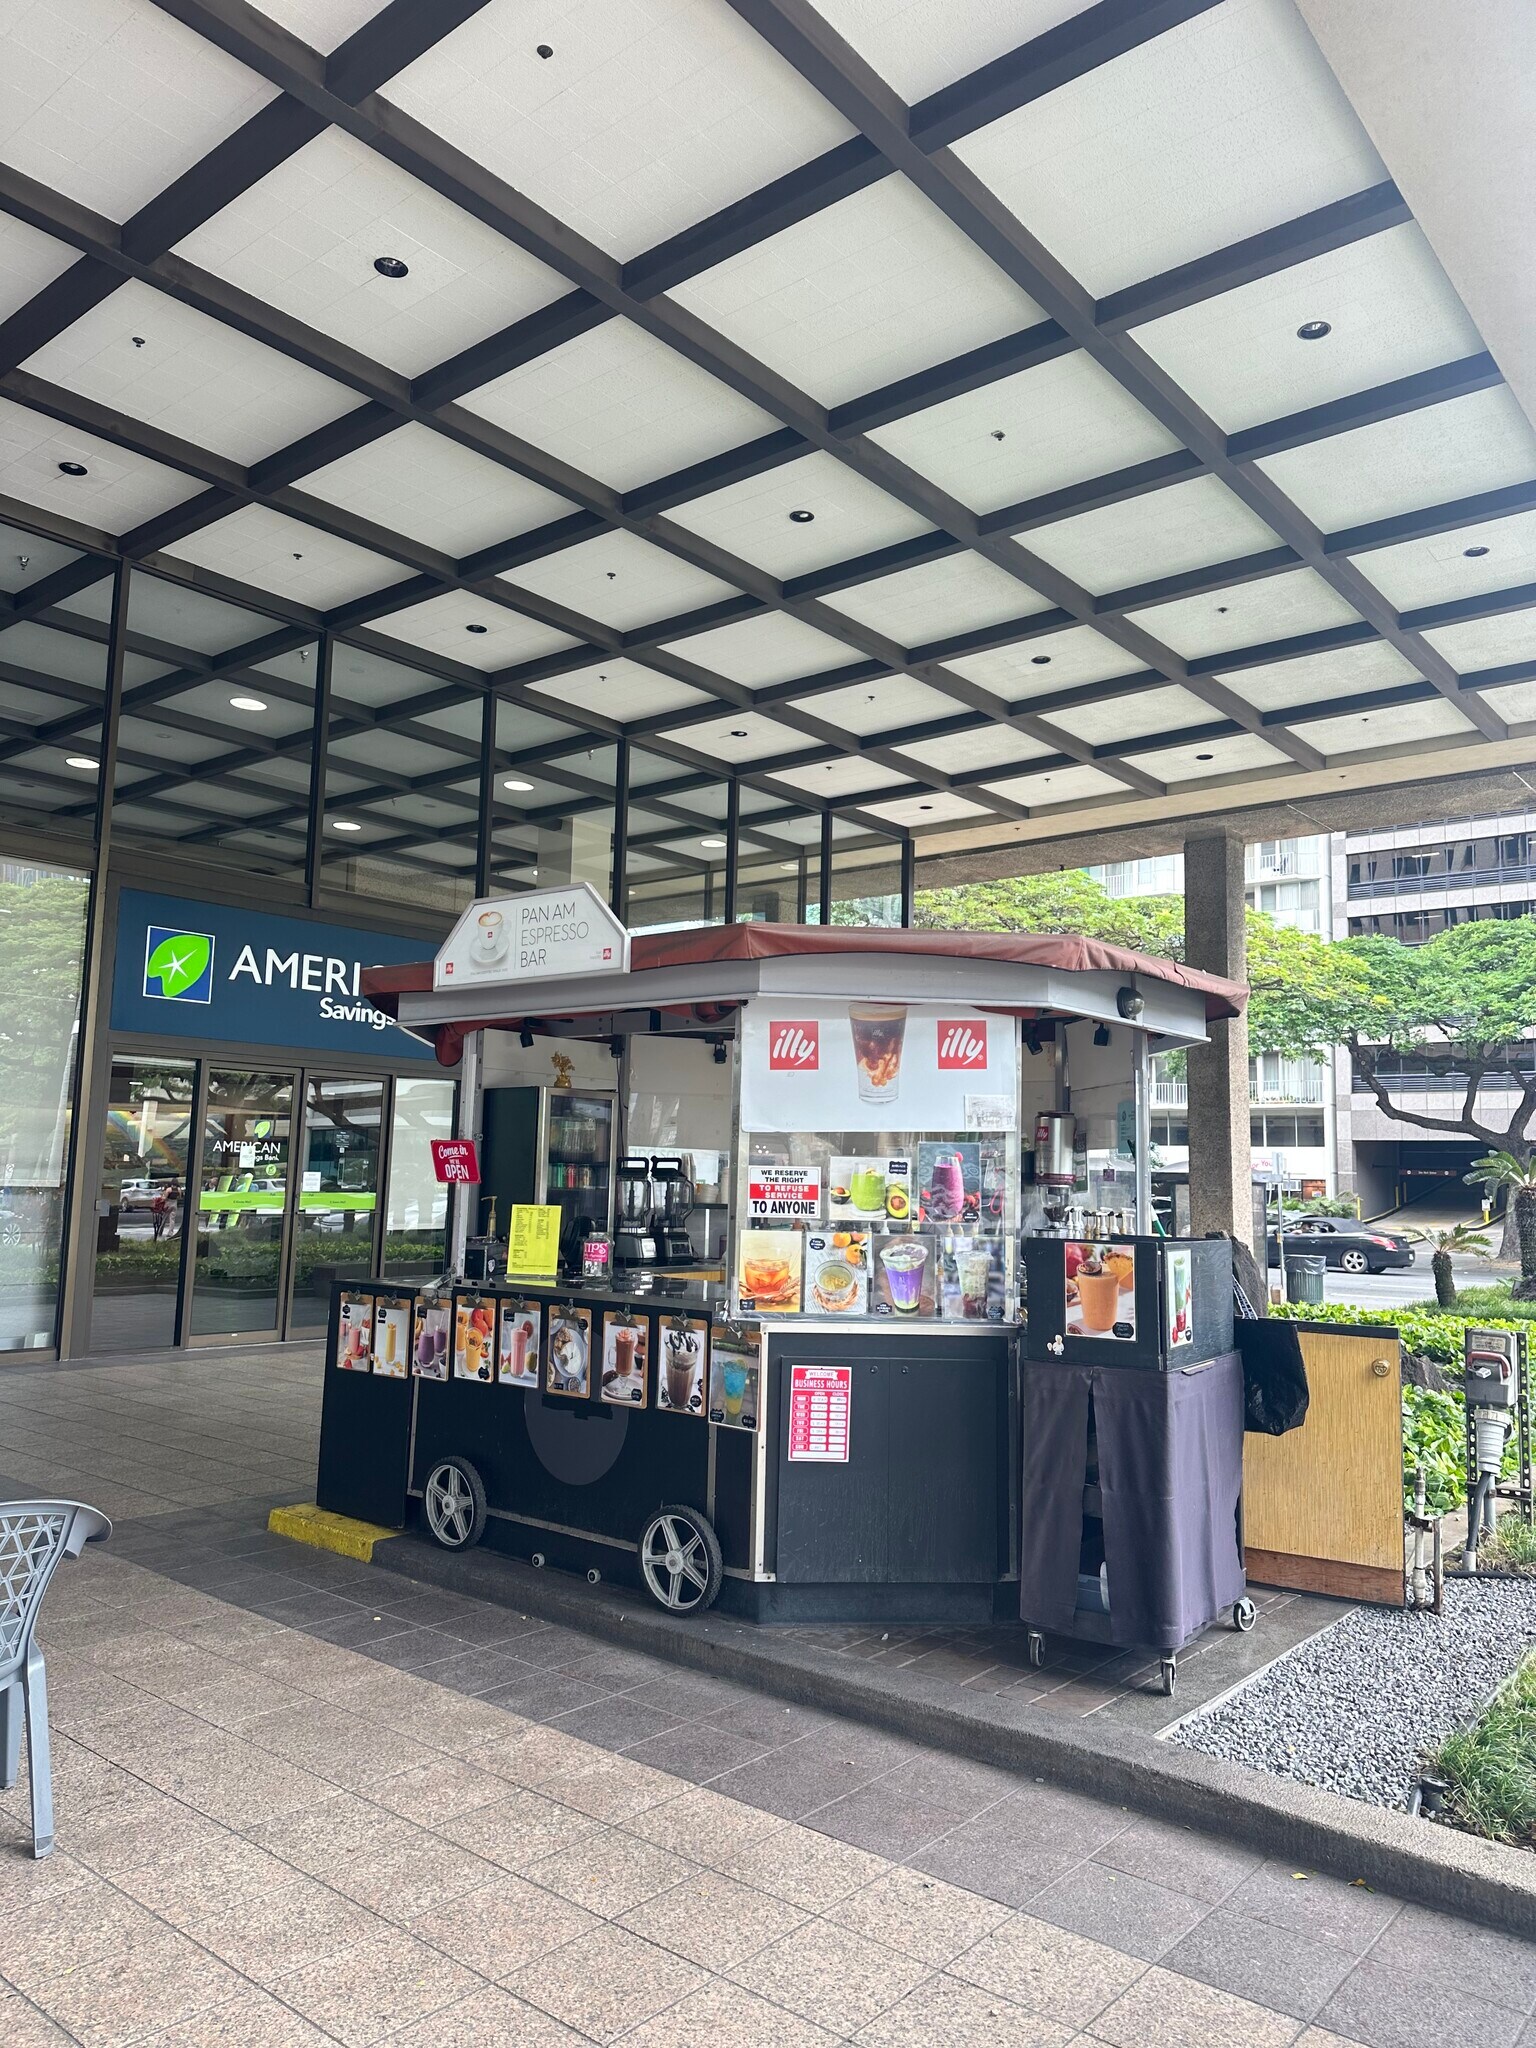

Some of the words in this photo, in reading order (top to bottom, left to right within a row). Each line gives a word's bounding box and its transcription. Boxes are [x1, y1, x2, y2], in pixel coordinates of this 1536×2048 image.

[522, 905, 549, 925] PAN
[552, 901, 575, 920] AM
[521, 921, 589, 946] ESPRESSO
[520, 948, 547, 968] BAR
[228, 945, 384, 997] AMERI
[773, 1028, 816, 1066] illy
[941, 1027, 984, 1065] illy
[438, 1144, 460, 1160] Come
[459, 1144, 469, 1156] in
[444, 1163, 470, 1180] OPEN
[774, 1169, 809, 1177] RESERVE
[758, 1184, 772, 1192] TO
[774, 1184, 810, 1193] REFUSE
[764, 1191, 804, 1200] SERVICE
[752, 1200, 768, 1214] TO
[770, 1200, 816, 1215] ANYONE
[794, 1379, 825, 1389] BUSINESS
[826, 1380, 848, 1389] HOURS
